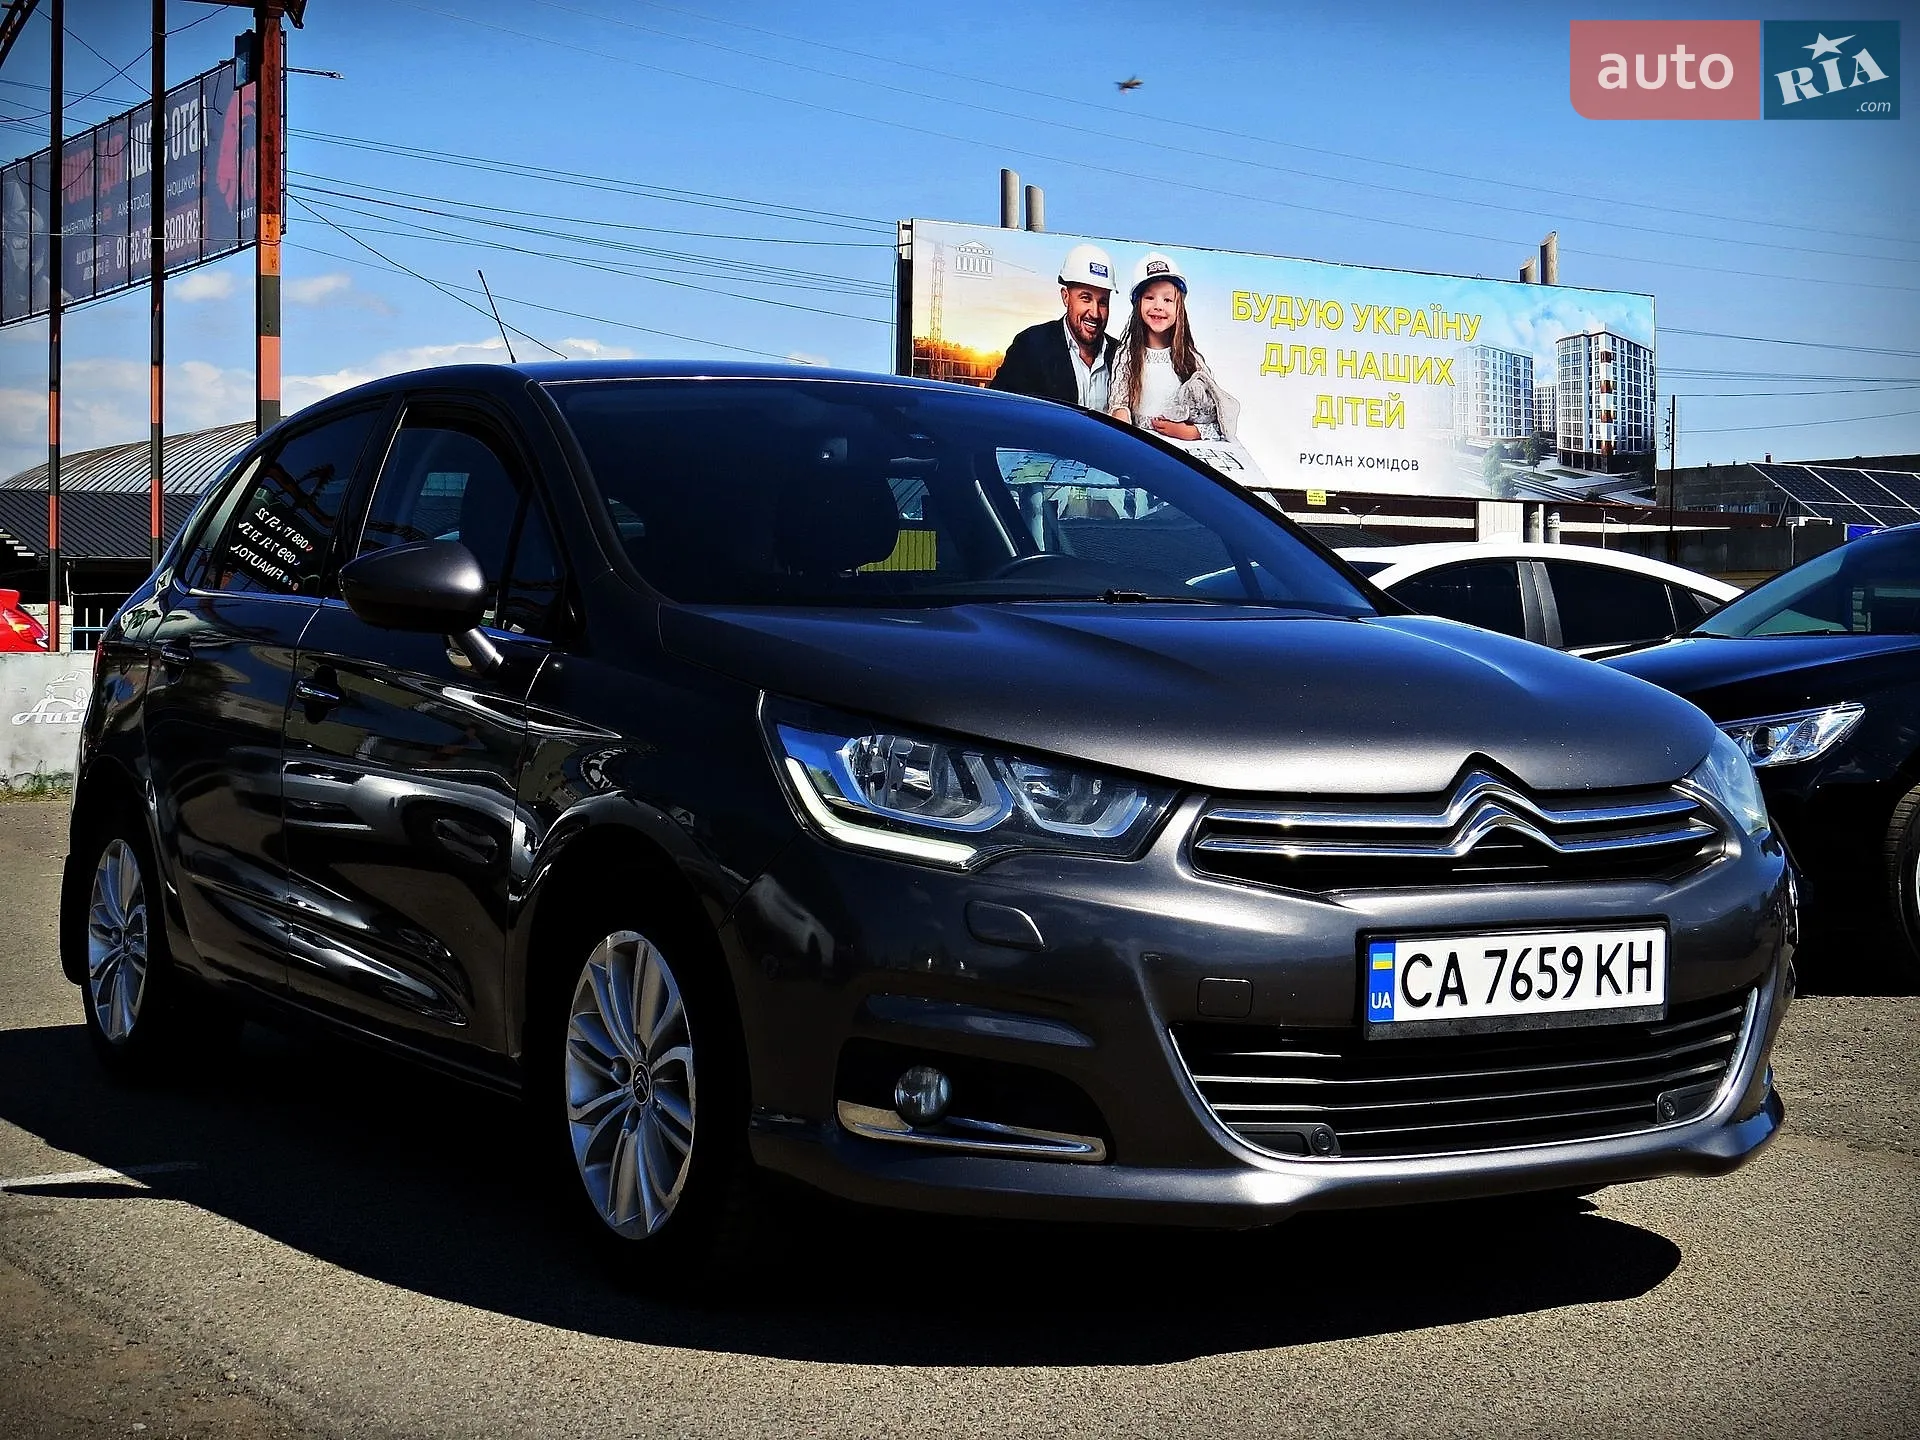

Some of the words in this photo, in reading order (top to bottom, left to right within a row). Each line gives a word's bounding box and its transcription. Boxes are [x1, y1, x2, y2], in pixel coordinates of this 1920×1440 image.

[1232, 290, 1344, 331] БУДУЮ
[1351, 303, 1482, 342] УКРАЇНУ
[1260, 342, 1327, 378] ДЛЯ
[1336, 349, 1455, 386] НАШИХ
[1312, 392, 1405, 430] ДІТЕЙ
[1299, 453, 1353, 468] РУСЛАН
[1357, 456, 1420, 472] ХОМІДОВ
[1401, 951, 1468, 1008] CA
[1484, 945, 1584, 1004] 7659
[1595, 940, 1653, 997] KH
[1371, 992, 1392, 1009] UA
